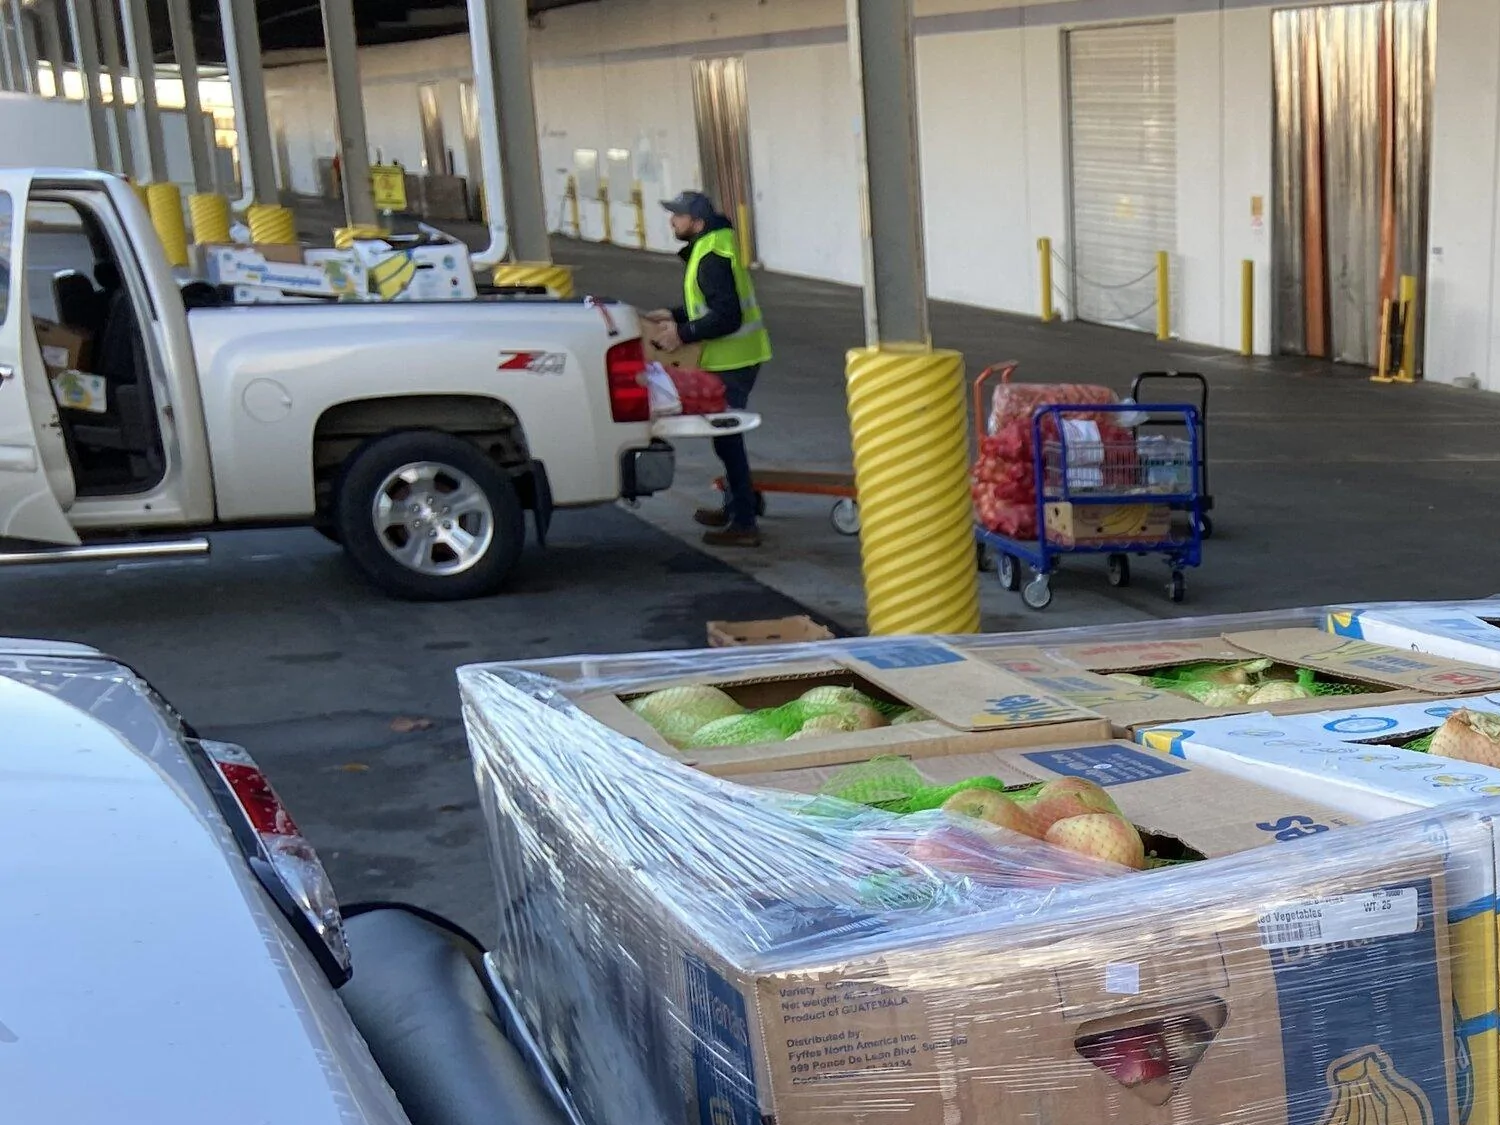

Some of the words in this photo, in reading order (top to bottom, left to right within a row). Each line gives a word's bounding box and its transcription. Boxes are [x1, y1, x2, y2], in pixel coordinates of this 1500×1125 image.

[1381, 899, 1392, 911] 25
[1273, 908, 1323, 923] Vegetables
[783, 1010, 826, 1023] Product
[828, 1006, 840, 1017] of
[841, 996, 910, 1015] GUATEMALA
[787, 1031, 845, 1048] Distributed
[788, 1048, 822, 1062] Fyffes
[825, 1045, 854, 1056] North
[856, 1036, 899, 1051] America
